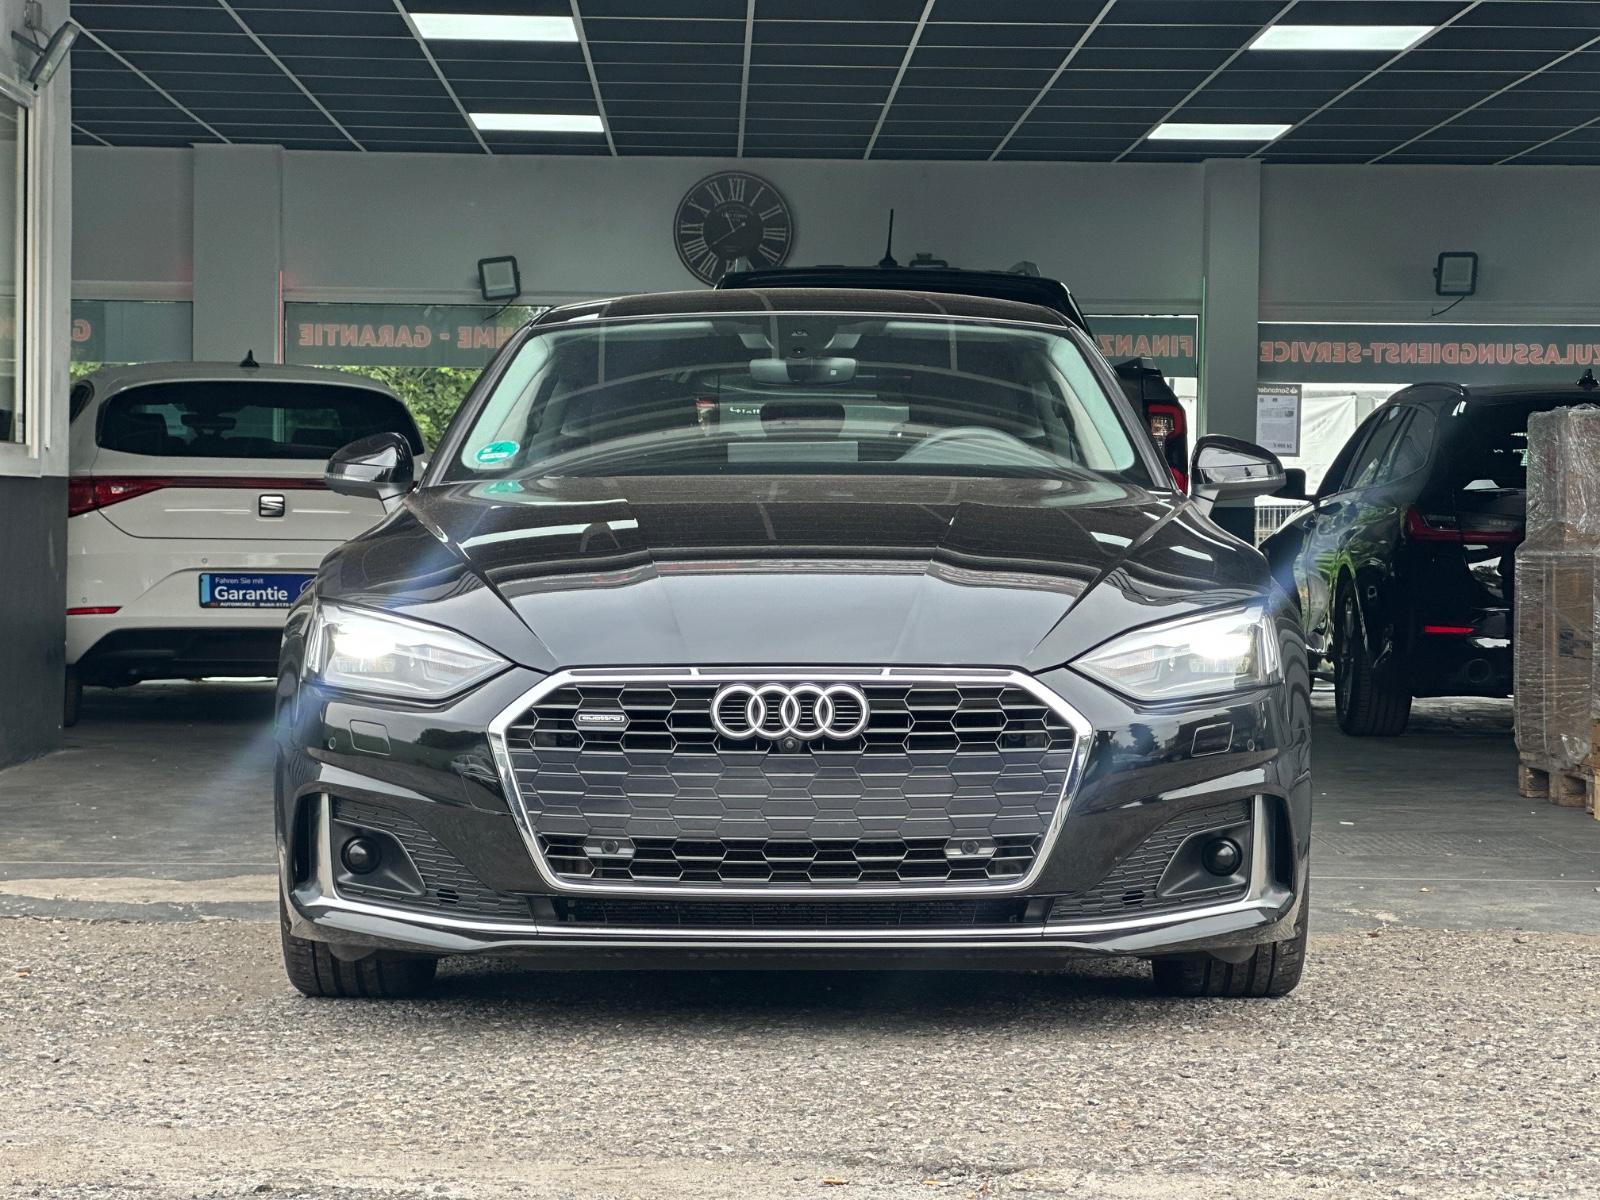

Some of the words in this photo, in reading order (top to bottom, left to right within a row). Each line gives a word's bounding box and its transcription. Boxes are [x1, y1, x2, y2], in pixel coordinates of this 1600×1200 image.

[724, 177, 746, 201] XII
[758, 202, 783, 221] II
[763, 227, 787, 241] III
[214, 586, 288, 600] Garantie
